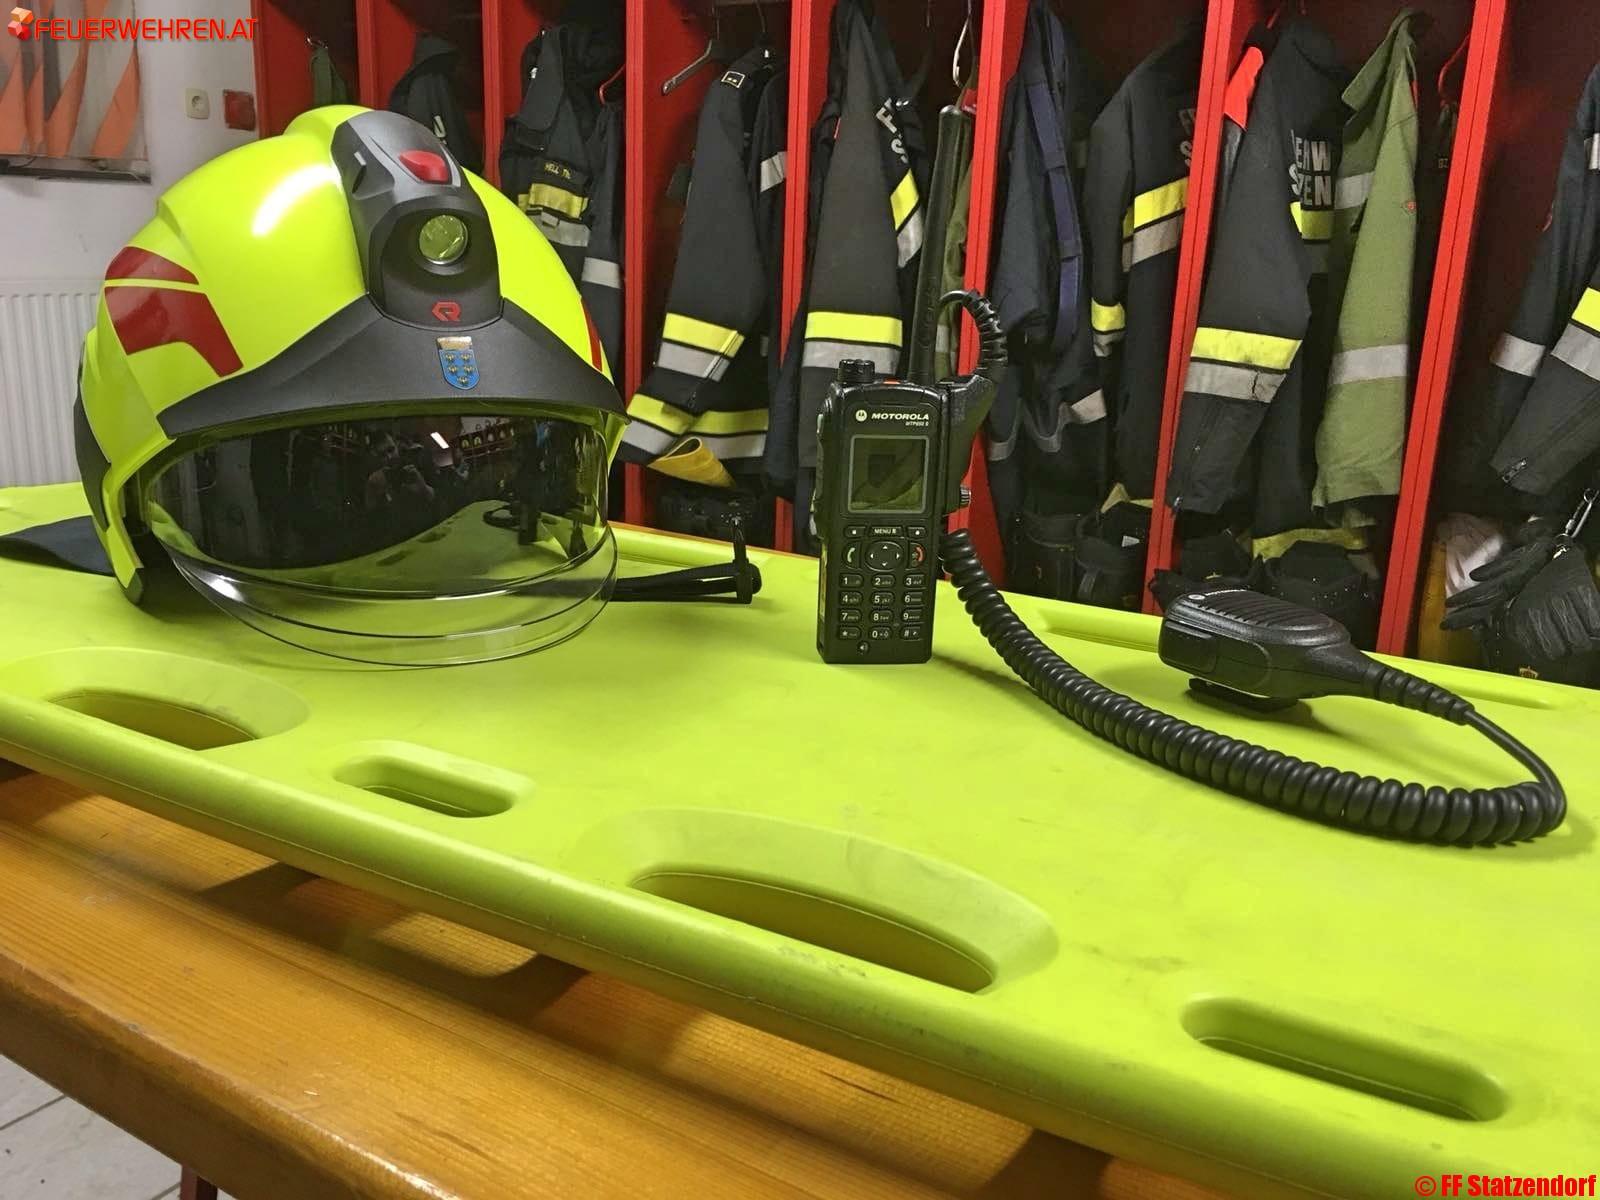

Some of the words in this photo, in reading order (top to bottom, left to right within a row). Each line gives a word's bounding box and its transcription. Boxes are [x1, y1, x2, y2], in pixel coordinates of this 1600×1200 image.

[871, 412, 930, 421] MOTOROLA
[874, 577, 881, 586] 2
[905, 577, 912, 586] 3
[842, 594, 848, 603] 4
[874, 595, 881, 603] 5
[904, 594, 911, 603] 6
[841, 612, 848, 621] 7
[873, 613, 879, 621] 8
[903, 612, 909, 620] 9
[872, 630, 878, 638] 0
